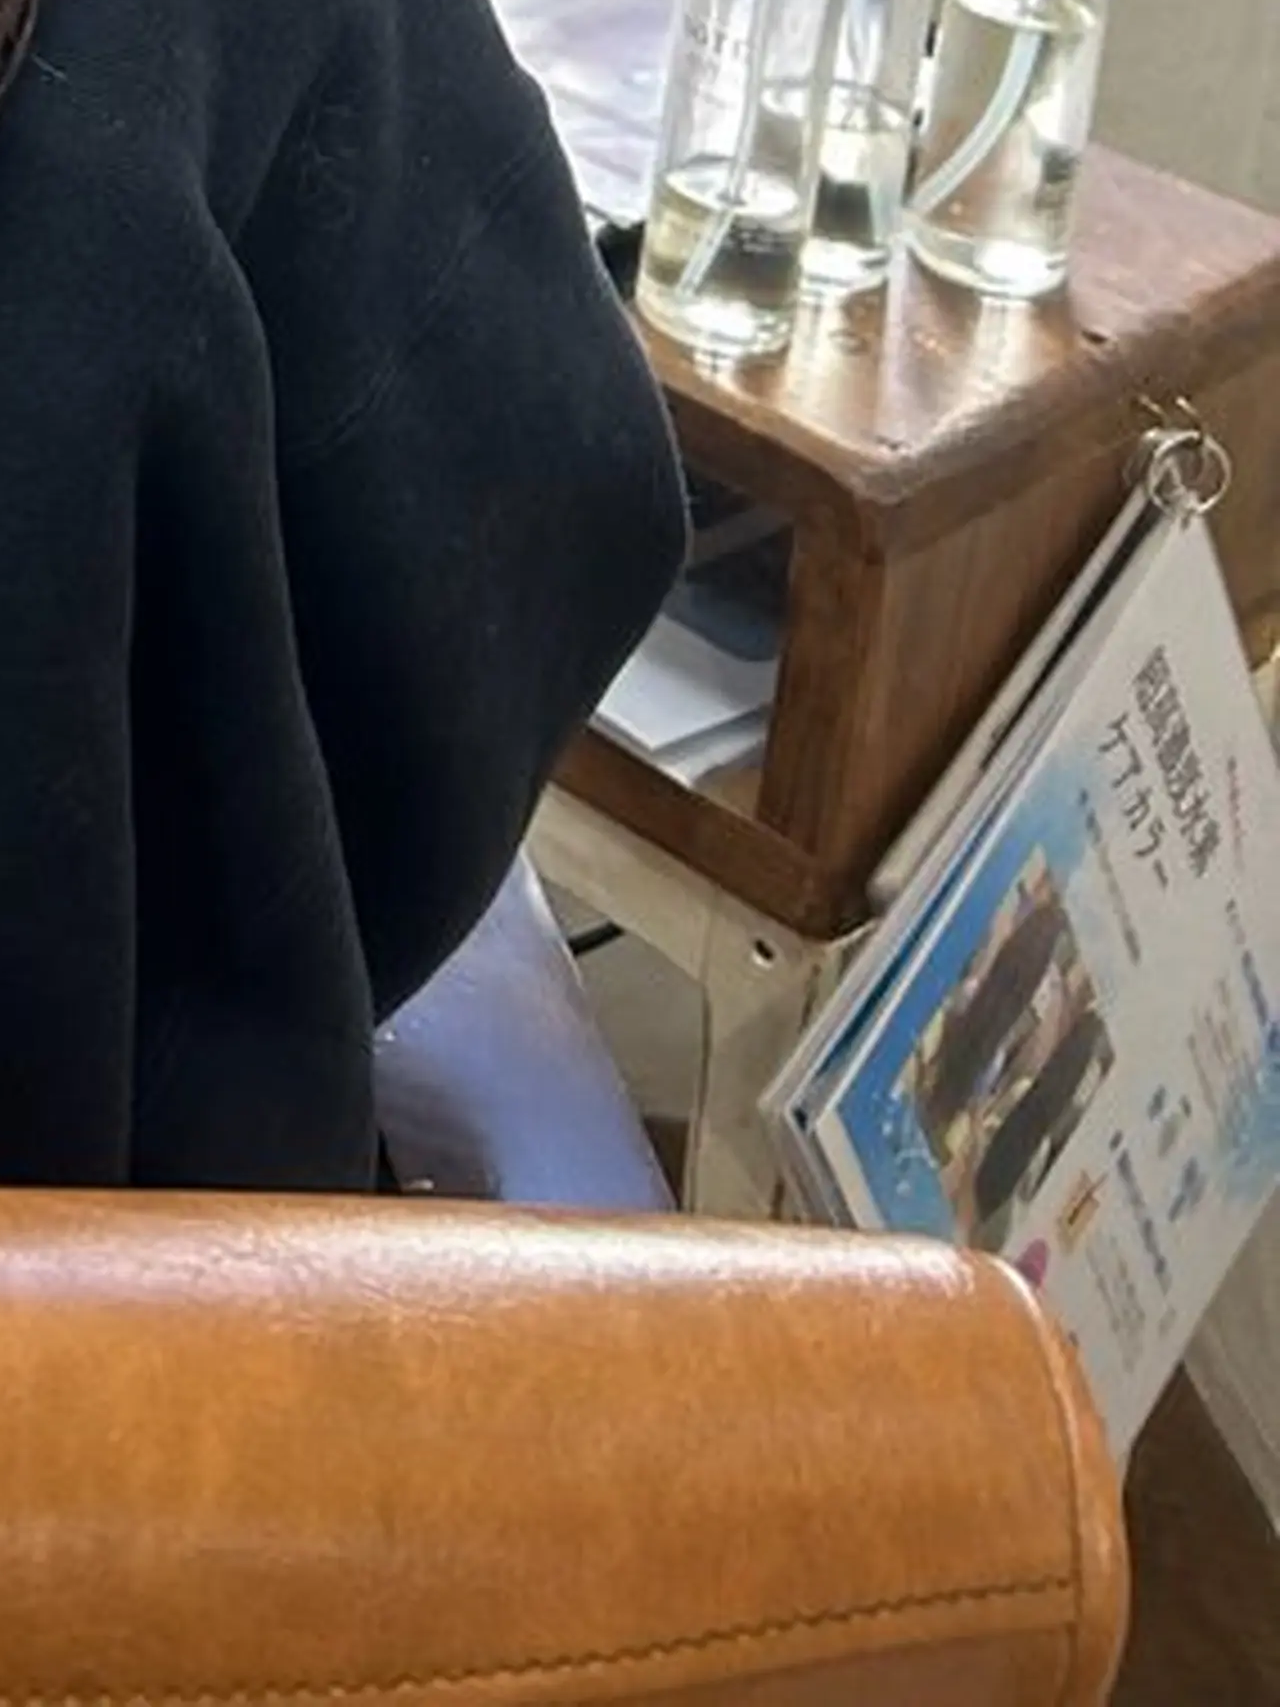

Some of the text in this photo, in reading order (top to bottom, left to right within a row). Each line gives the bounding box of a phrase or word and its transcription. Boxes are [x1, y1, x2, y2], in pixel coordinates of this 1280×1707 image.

[1097, 711, 1170, 889] ケアカラー
